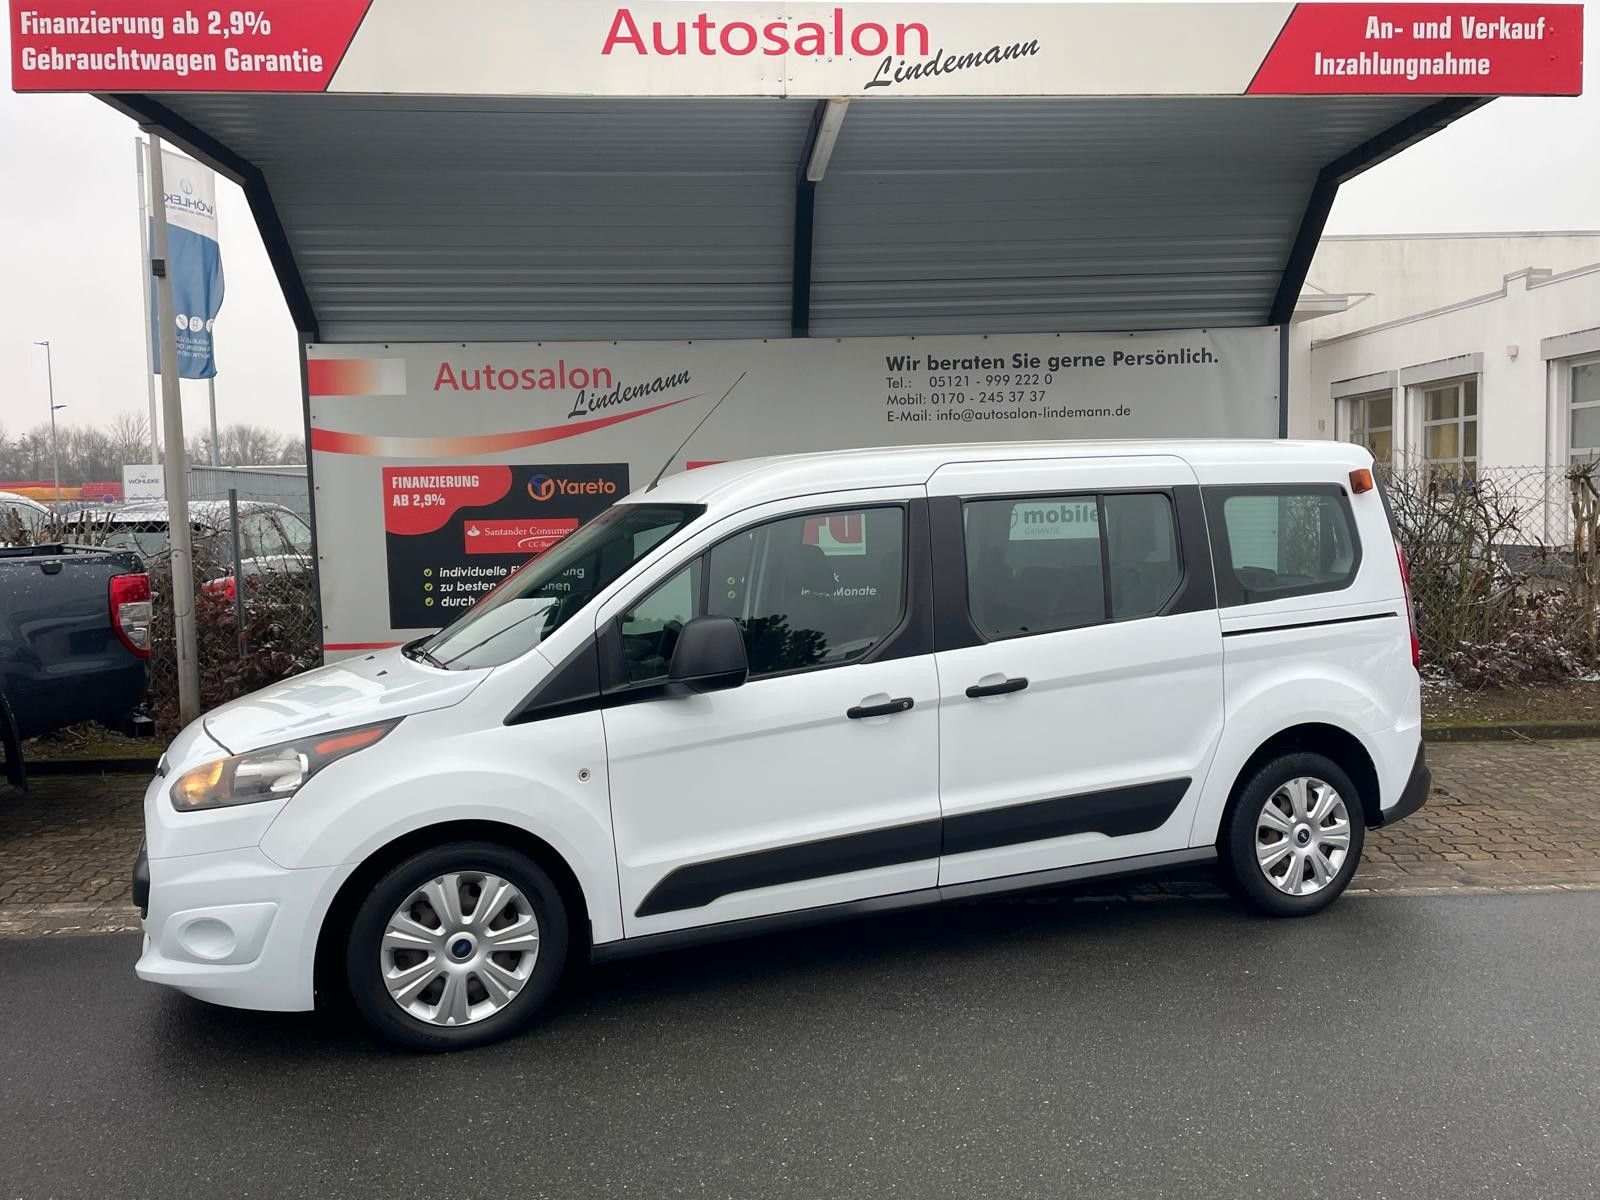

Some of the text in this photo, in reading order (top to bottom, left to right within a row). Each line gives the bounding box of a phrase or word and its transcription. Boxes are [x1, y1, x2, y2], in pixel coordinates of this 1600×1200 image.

[20, 11, 271, 39] Finanzierung ab 2,9%
[601, 8, 929, 57] Autosalon
[1365, 16, 1546, 40] An- und Verkauf
[22, 47, 323, 76] Gebrauchtwagen Garantie
[863, 37, 1041, 90] Lindemann
[1314, 52, 1491, 80] Inzahlungnahme
[886, 347, 1219, 372] Wir beraten Sie gerne Persönlich.
[433, 360, 613, 391] Autosalon
[886, 377, 912, 389] Tel.:
[929, 375, 969, 388] 05121
[985, 374, 1010, 387] 999
[1015, 374, 1040, 386] 222
[1044, 373, 1053, 385] 0
[568, 370, 691, 419] Lindemann
[886, 393, 927, 406] Mobil:
[931, 392, 965, 405] 0170
[979, 391, 1005, 404] 245
[1009, 391, 1025, 403] 37
[1030, 390, 1046, 403] 37
[887, 404, 1131, 422] E-Mail: info@autosalon-lindemann.de
[392, 475, 480, 489] FINANZIERUNG
[557, 479, 617, 496] Yareto
[393, 494, 446, 507] AB 2,9%
[1023, 504, 1098, 525] mobile
[485, 526, 527, 537] Santander
[439, 566, 508, 578] individuelle
[440, 584, 453, 592] zu
[441, 596, 476, 607] durch
